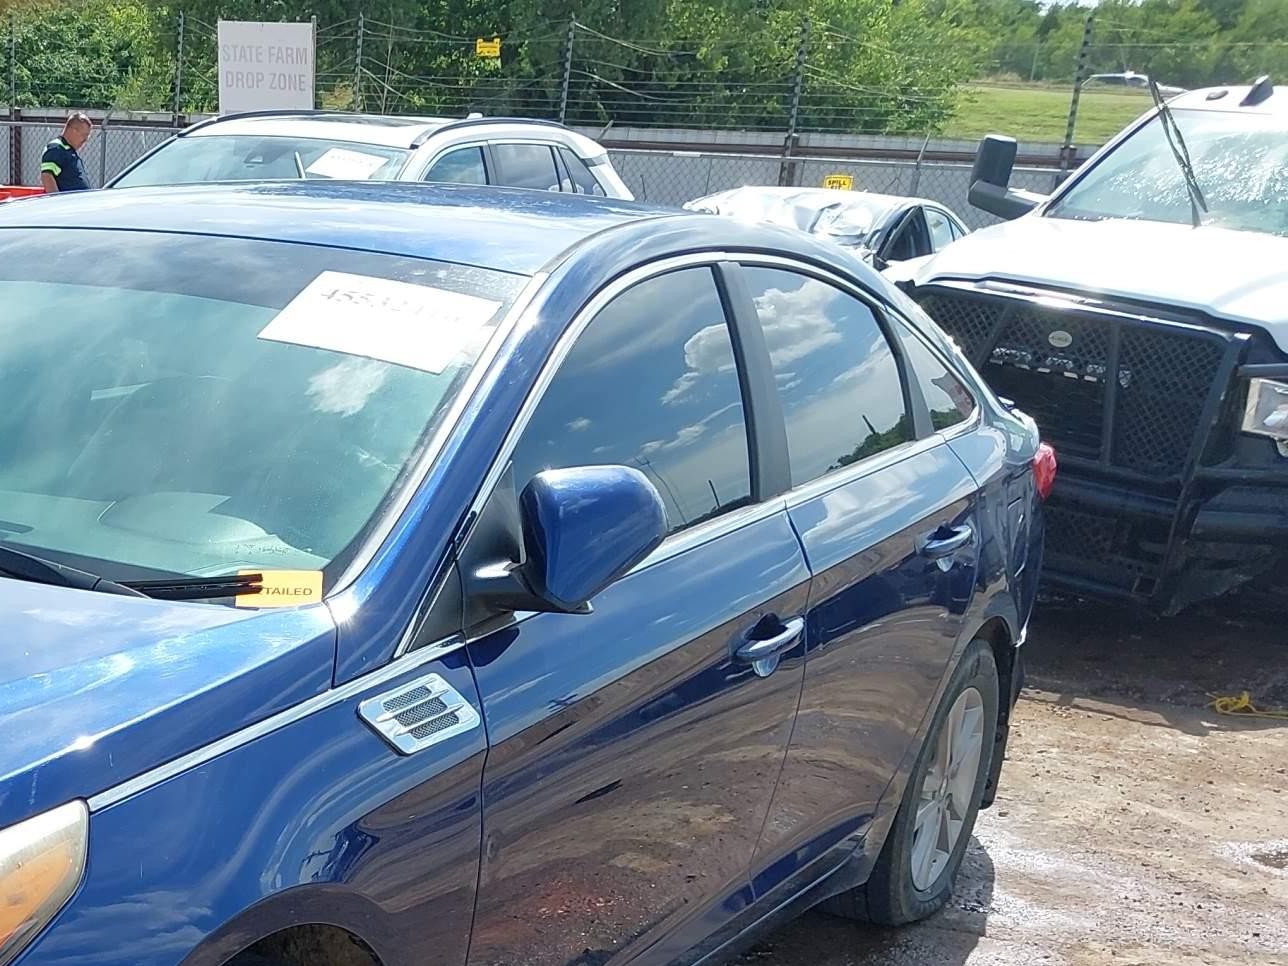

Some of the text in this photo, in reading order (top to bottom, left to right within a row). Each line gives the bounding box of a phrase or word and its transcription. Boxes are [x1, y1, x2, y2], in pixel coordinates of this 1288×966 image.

[222, 44, 308, 65] STATE FARM
[225, 71, 306, 91] DROP ZONE
